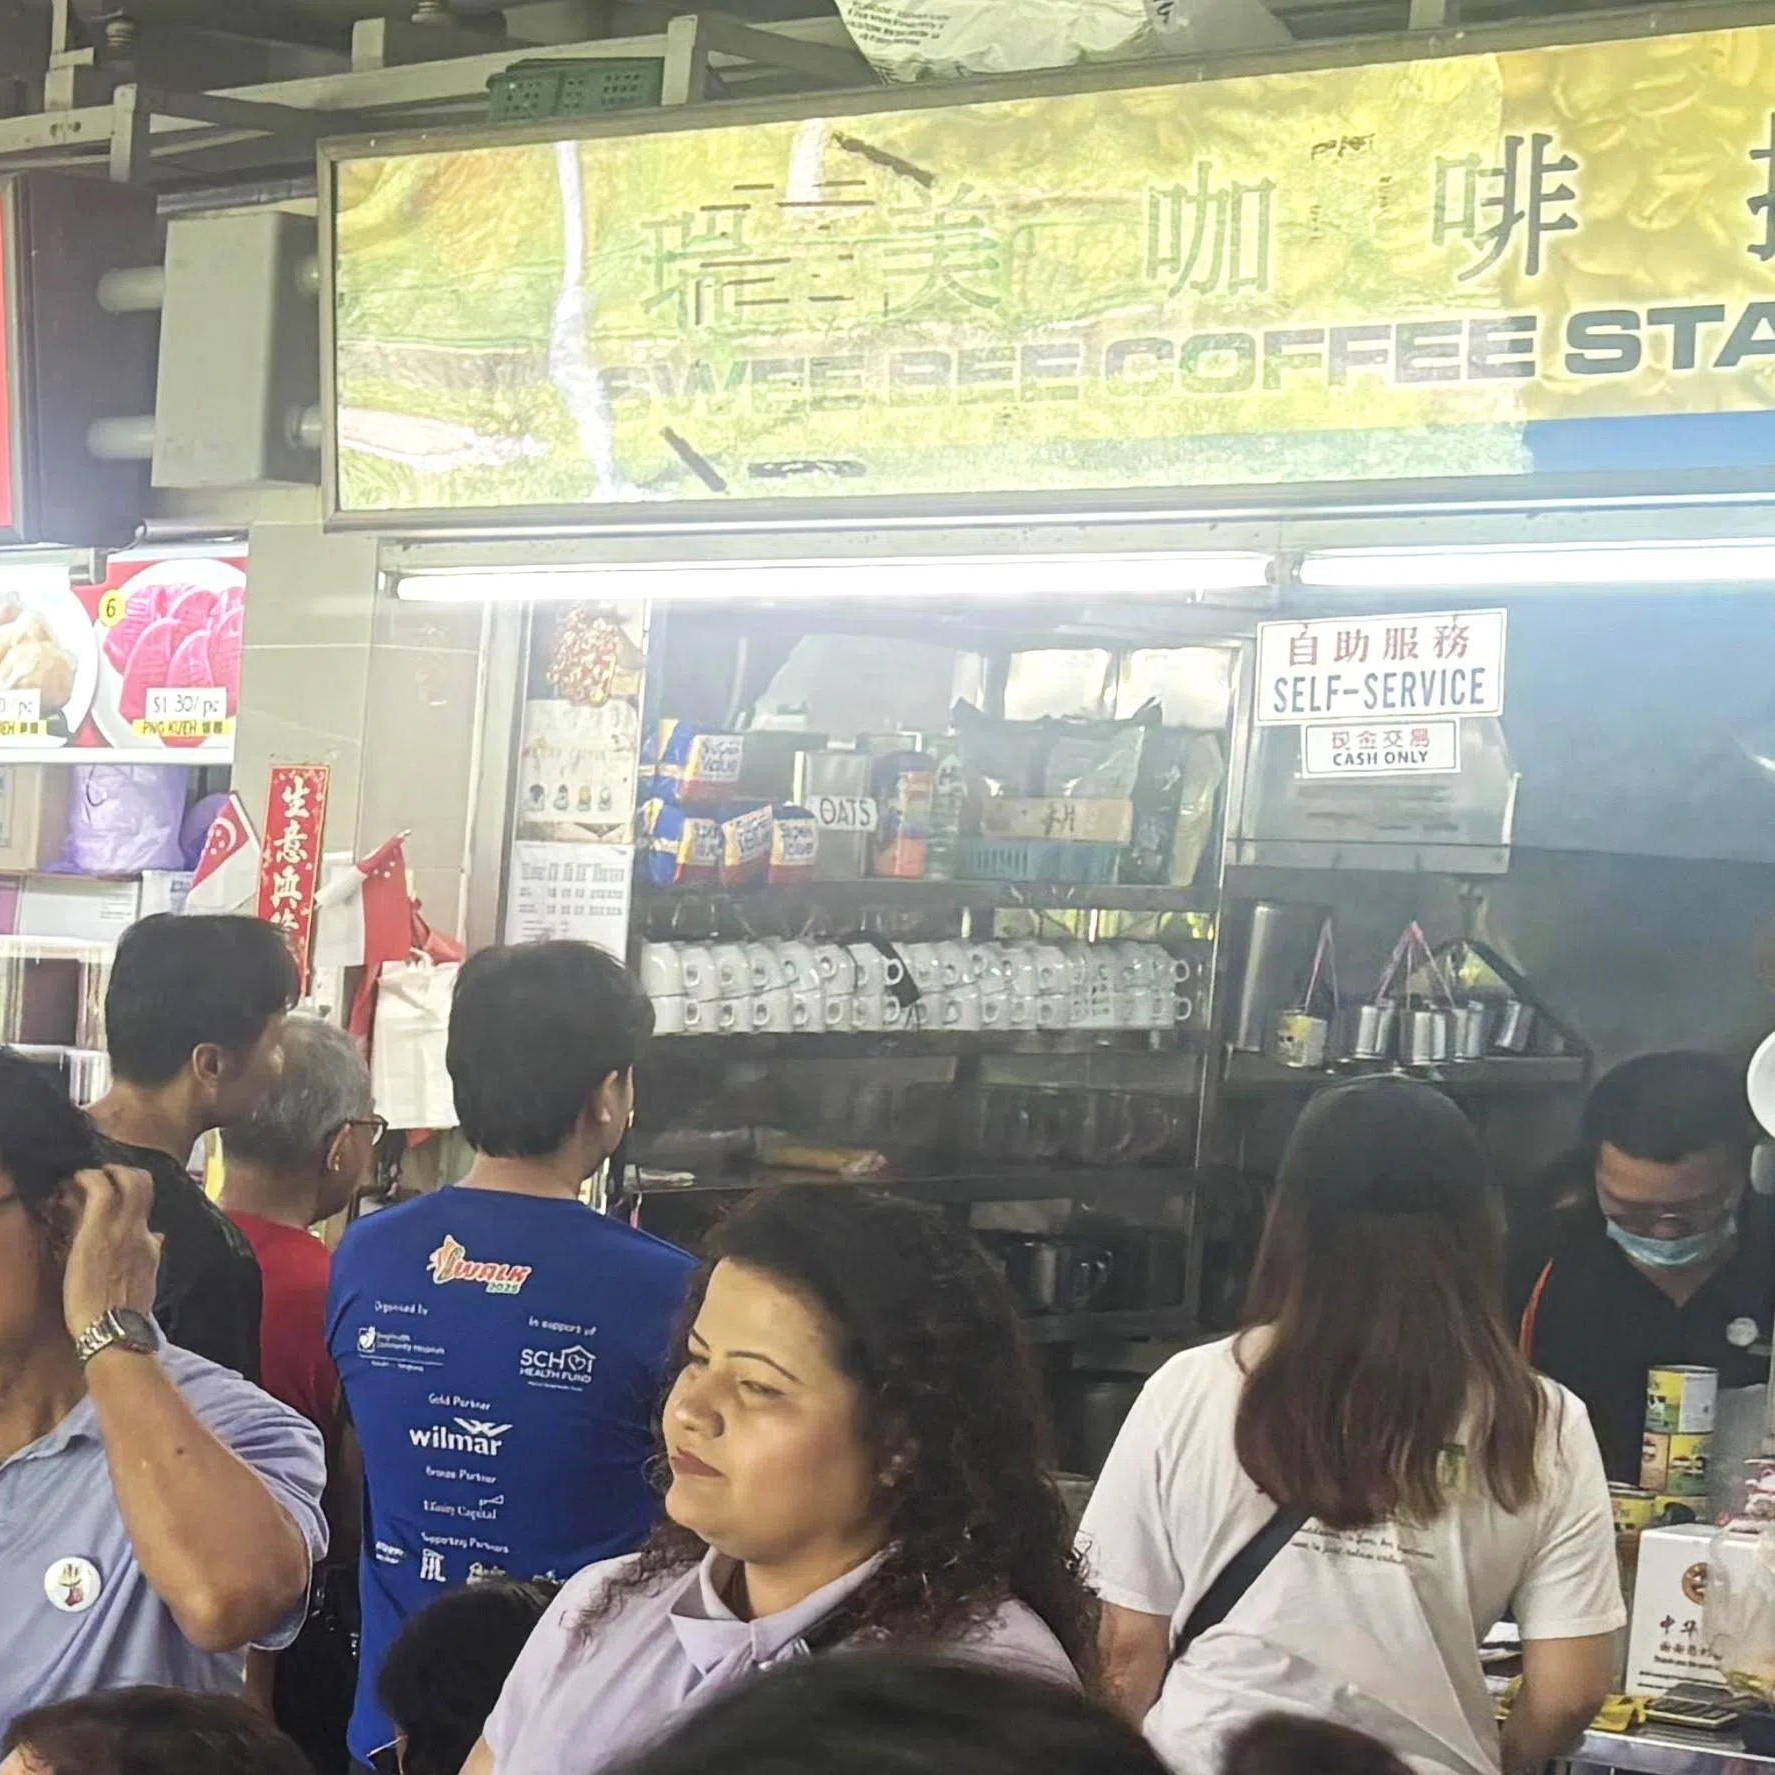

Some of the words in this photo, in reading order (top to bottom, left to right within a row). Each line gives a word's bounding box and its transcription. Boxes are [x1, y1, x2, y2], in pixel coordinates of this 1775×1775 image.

[1105, 315, 1538, 396] COFFEE
[106, 599, 116, 619] 6
[1289, 622, 1470, 667] 自助服務
[1273, 667, 1486, 714] SELF-SERVICE
[142, 721, 167, 736] PNG
[169, 721, 197, 736] KUEH
[1333, 751, 1378, 766] CASH
[1384, 749, 1429, 764] ONLY
[820, 797, 871, 827] OATS
[542, 1320, 581, 1334] support
[520, 1367, 560, 1379] HEALTH
[561, 1371, 593, 1384] FUND
[428, 1392, 450, 1406] Gold
[452, 1395, 491, 1411] Partner
[409, 1425, 502, 1456] wilmar
